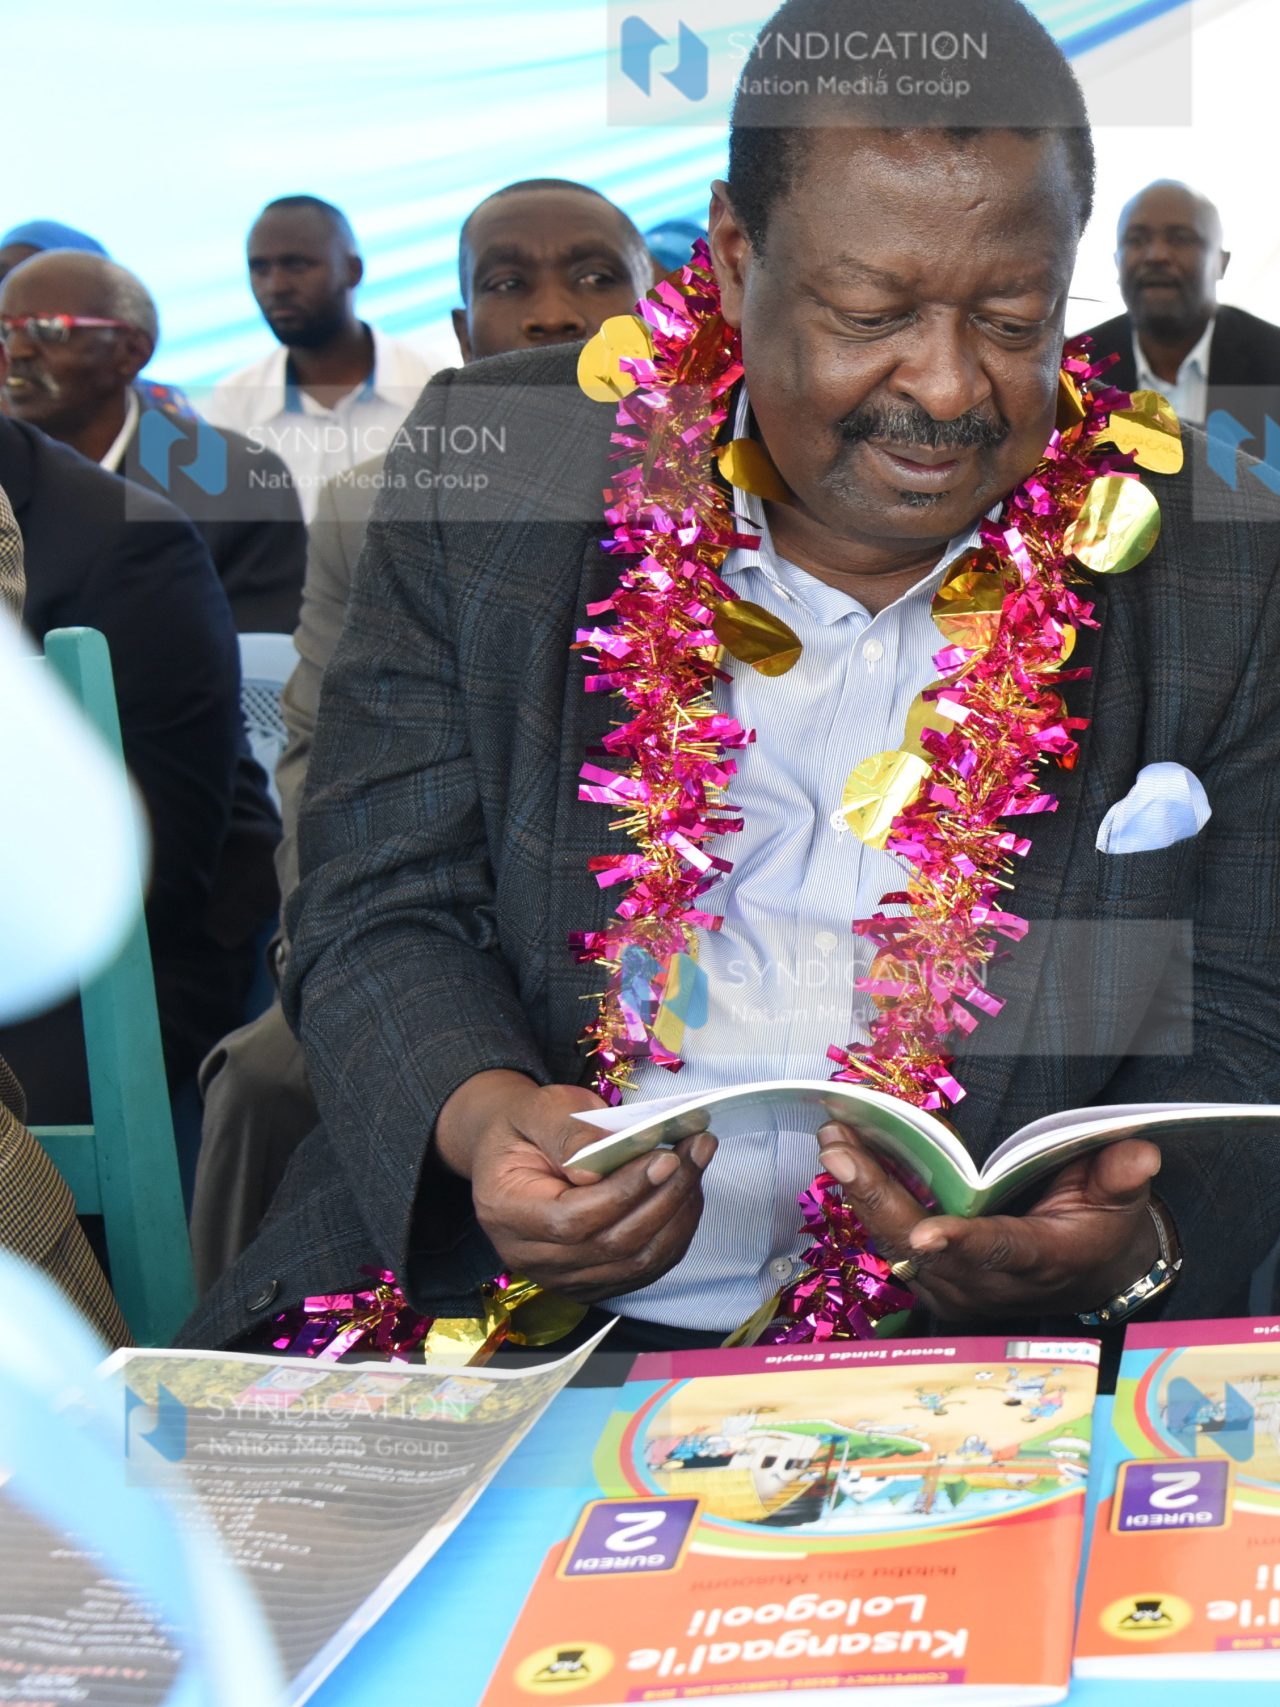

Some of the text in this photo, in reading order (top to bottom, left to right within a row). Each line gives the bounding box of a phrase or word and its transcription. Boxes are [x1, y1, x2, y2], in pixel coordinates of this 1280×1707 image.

[828, 1351, 891, 1365] Ininda
[895, 1347, 956, 1361] Benard
[1040, 1346, 1091, 1357] EAEP
[1149, 1468, 1201, 1510] 2
[1125, 1509, 1214, 1526] GUREDI
[603, 1510, 668, 1553] 2
[573, 1553, 667, 1573] GUREDI
[688, 1563, 958, 1593] Ikitabu chu Musoomi
[685, 1592, 929, 1637] Lologooli
[626, 1628, 970, 1677] Kusangaal'le
